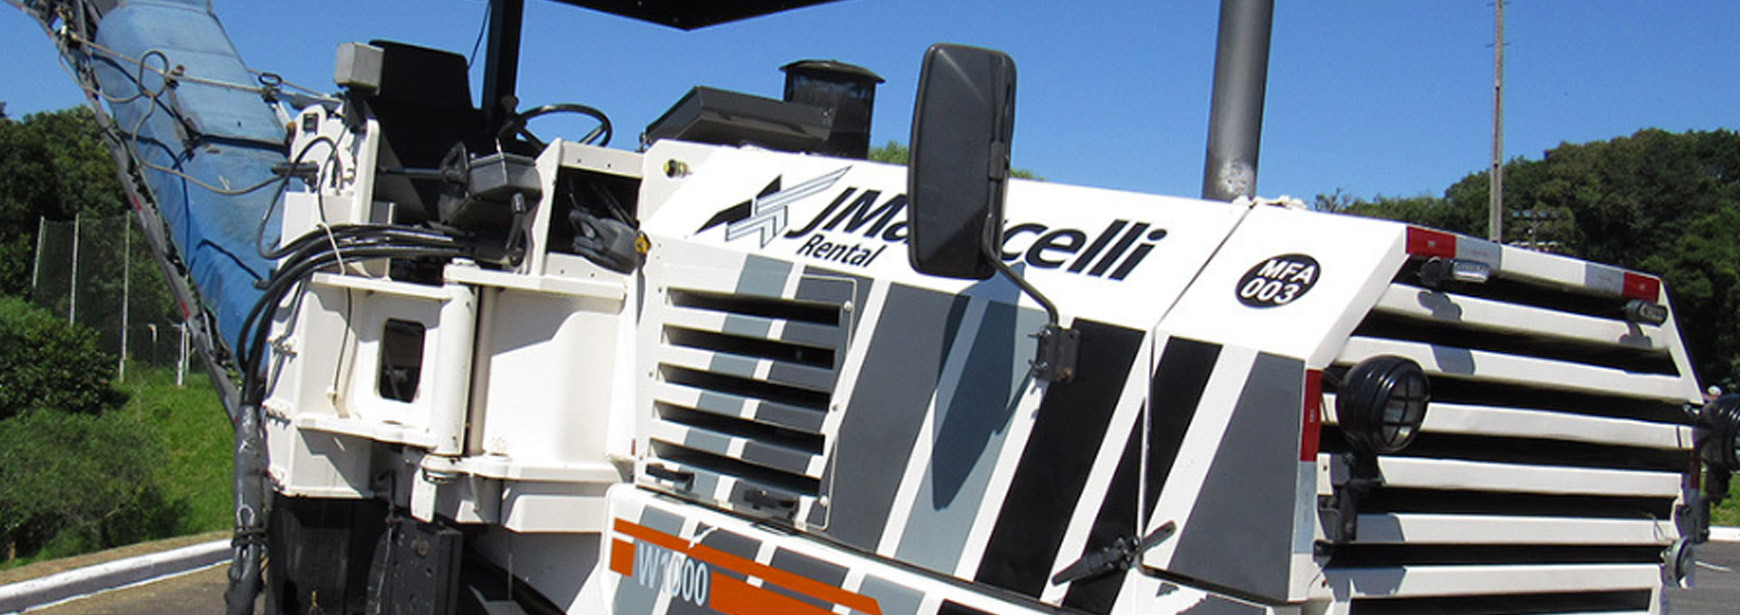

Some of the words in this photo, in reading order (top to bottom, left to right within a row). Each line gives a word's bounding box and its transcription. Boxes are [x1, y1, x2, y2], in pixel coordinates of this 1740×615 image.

[796, 234, 888, 268] Rental
[1257, 259, 1316, 285] MFA
[1240, 277, 1300, 304] 003
[639, 542, 708, 606] W1000
